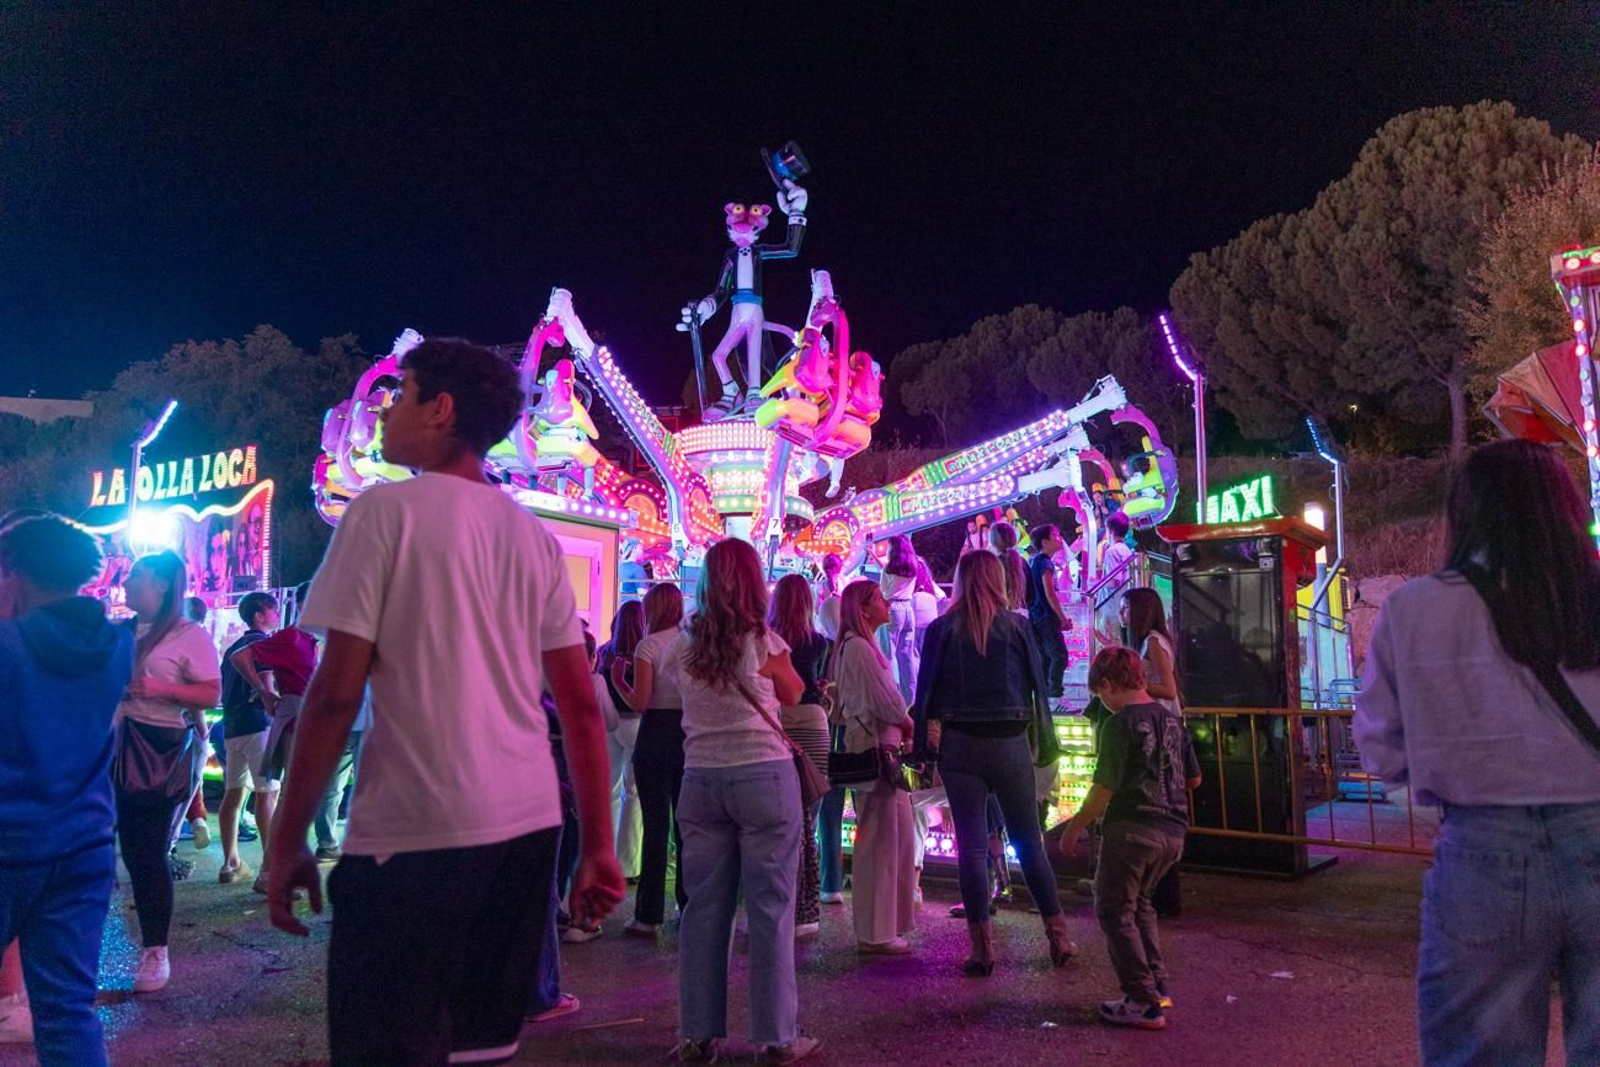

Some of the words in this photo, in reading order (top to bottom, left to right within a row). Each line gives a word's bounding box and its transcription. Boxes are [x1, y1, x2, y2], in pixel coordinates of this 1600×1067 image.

[91, 469, 125, 506] LA
[137, 458, 194, 501] OLLA
[198, 446, 256, 491] LOCA
[672, 523, 680, 534] 6
[772, 518, 779, 529] 7
